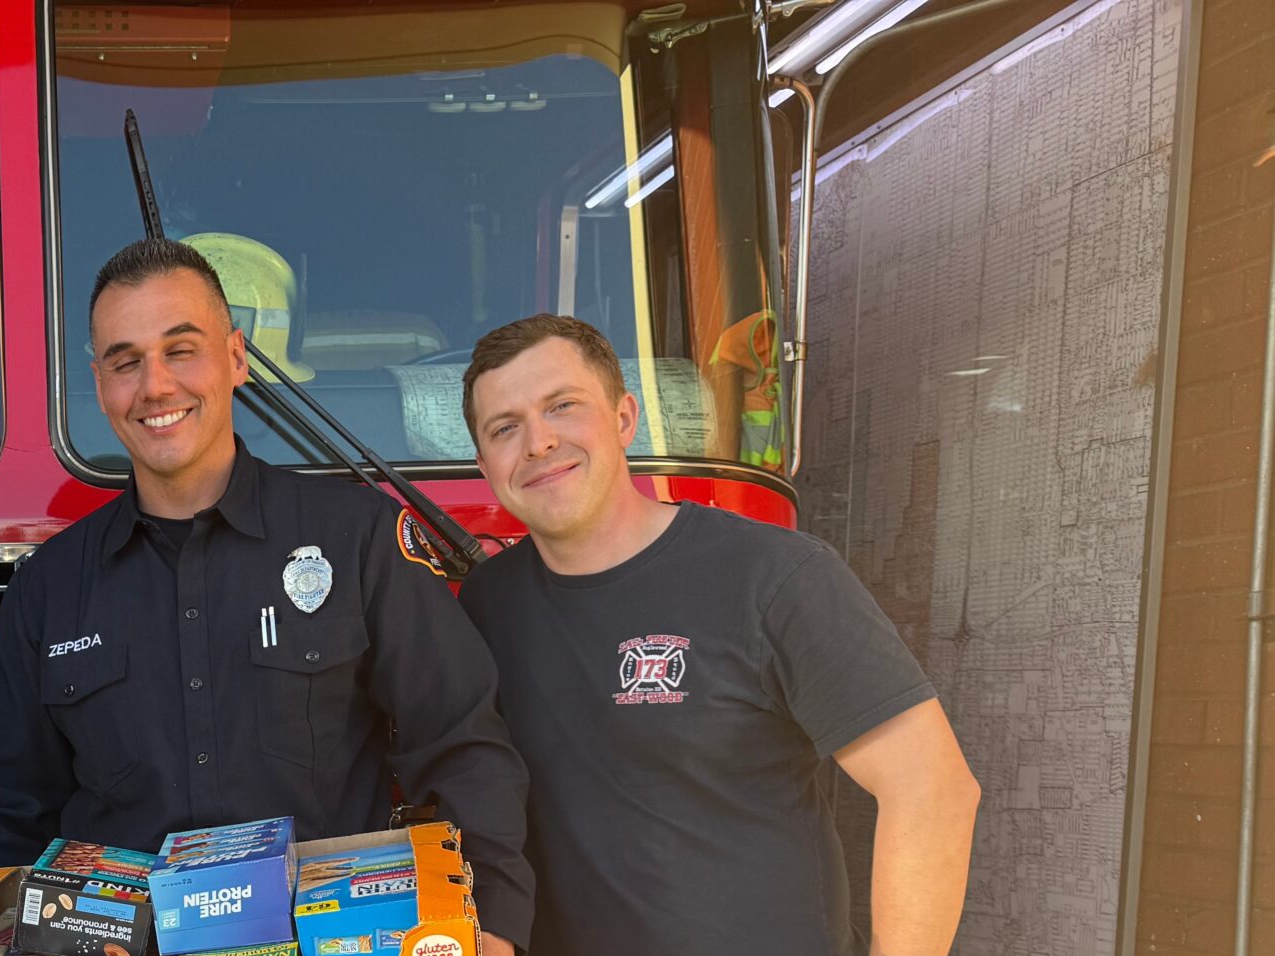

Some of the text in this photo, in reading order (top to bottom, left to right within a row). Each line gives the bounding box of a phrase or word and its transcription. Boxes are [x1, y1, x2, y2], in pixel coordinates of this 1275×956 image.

[48, 633, 102, 658] ZEPEDA
[633, 659, 669, 680] 173
[85, 880, 150, 897] KIND
[184, 885, 252, 908] PROTEIN
[200, 900, 242, 919] PURE
[67, 922, 83, 932] you
[163, 918, 176, 928] 23
[85, 927, 131, 943] ingredients
